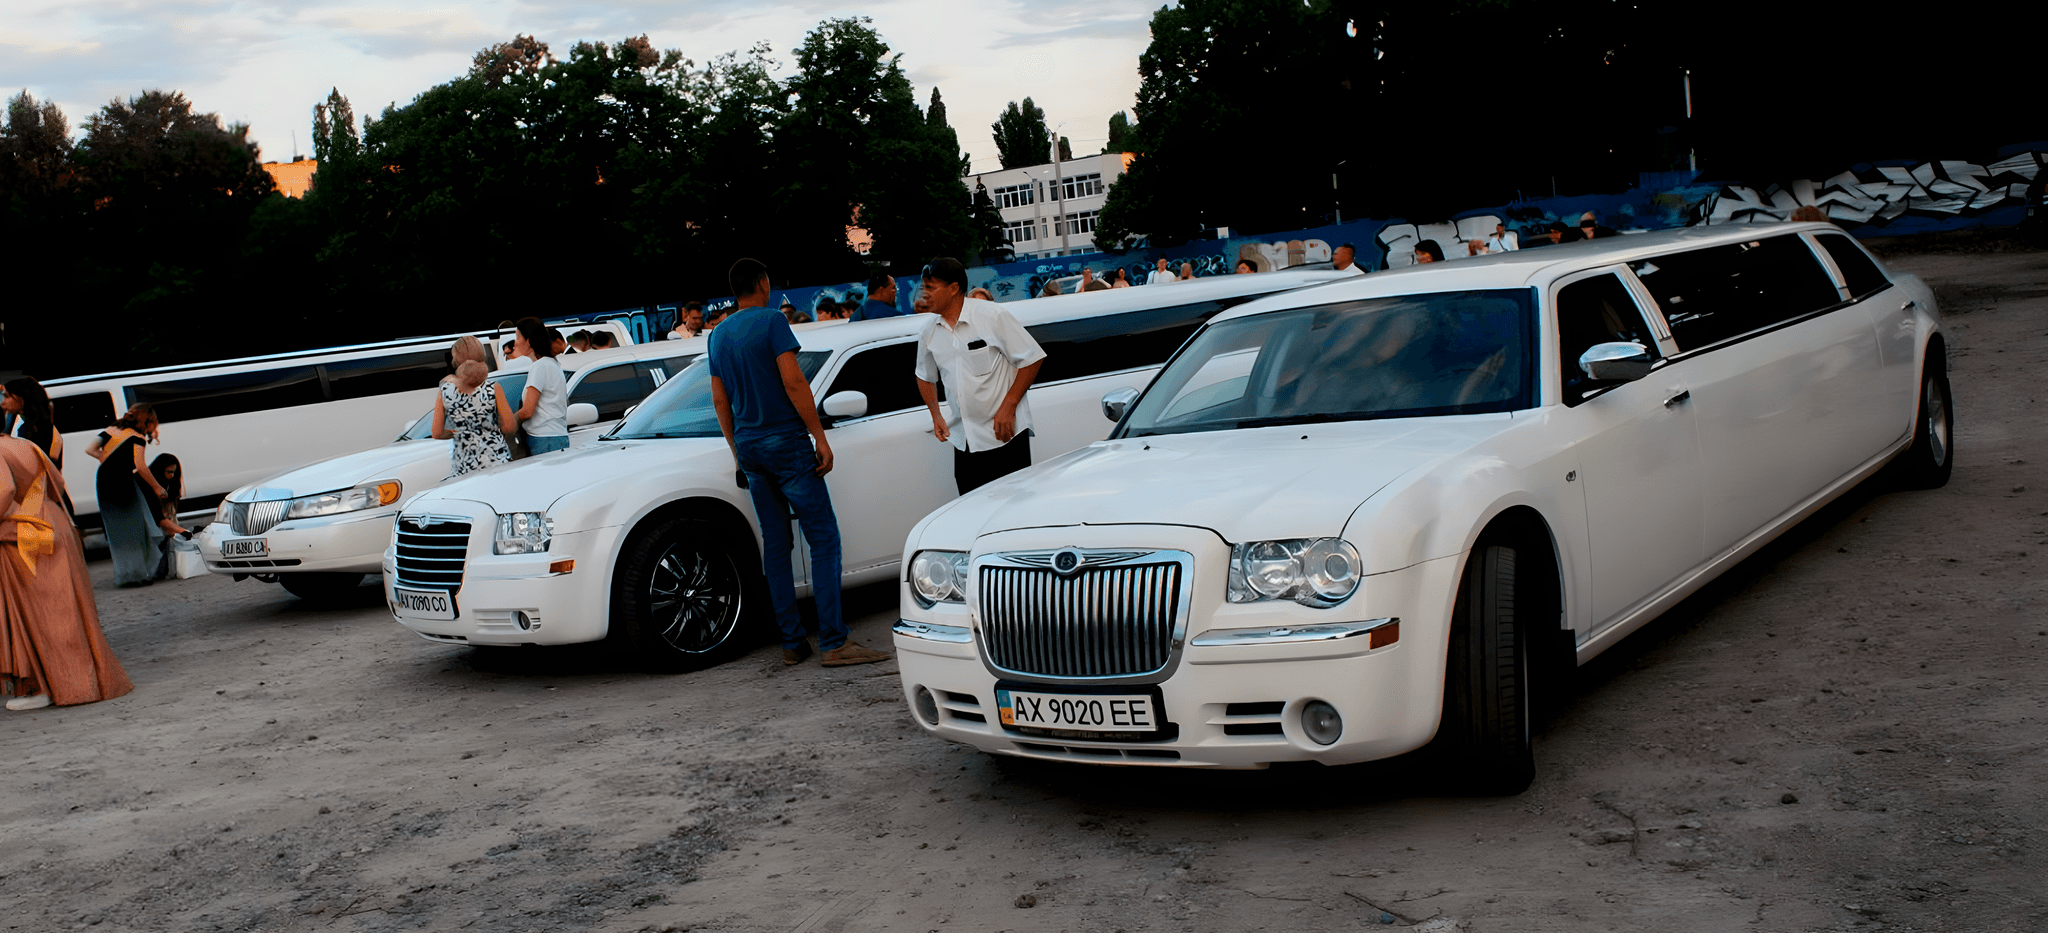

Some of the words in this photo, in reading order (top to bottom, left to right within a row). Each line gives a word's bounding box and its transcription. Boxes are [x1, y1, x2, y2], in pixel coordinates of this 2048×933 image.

[431, 596, 447, 612] CO
[1015, 696, 1045, 722] AX
[1048, 698, 1104, 726] 9020
[1109, 700, 1150, 726] EE
